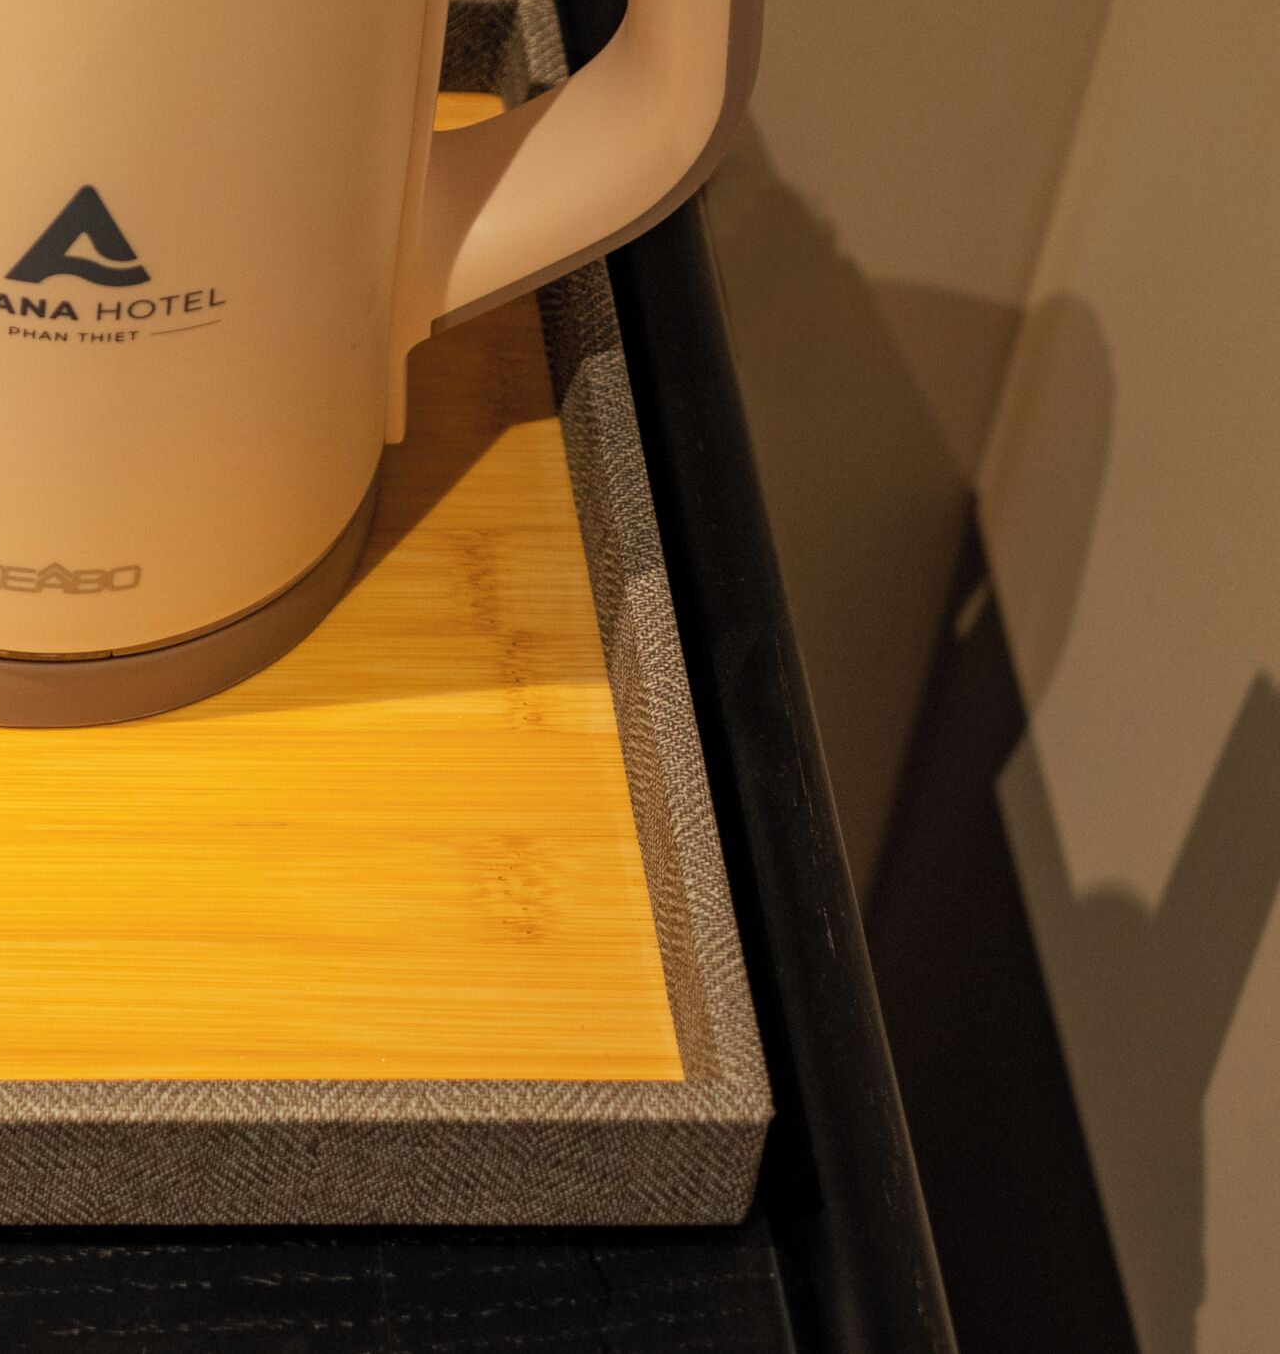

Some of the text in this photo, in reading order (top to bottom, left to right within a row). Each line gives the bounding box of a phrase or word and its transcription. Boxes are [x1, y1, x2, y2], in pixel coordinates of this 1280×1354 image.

[95, 287, 228, 321] HOTEL
[7, 325, 141, 343] PHAN THIET
